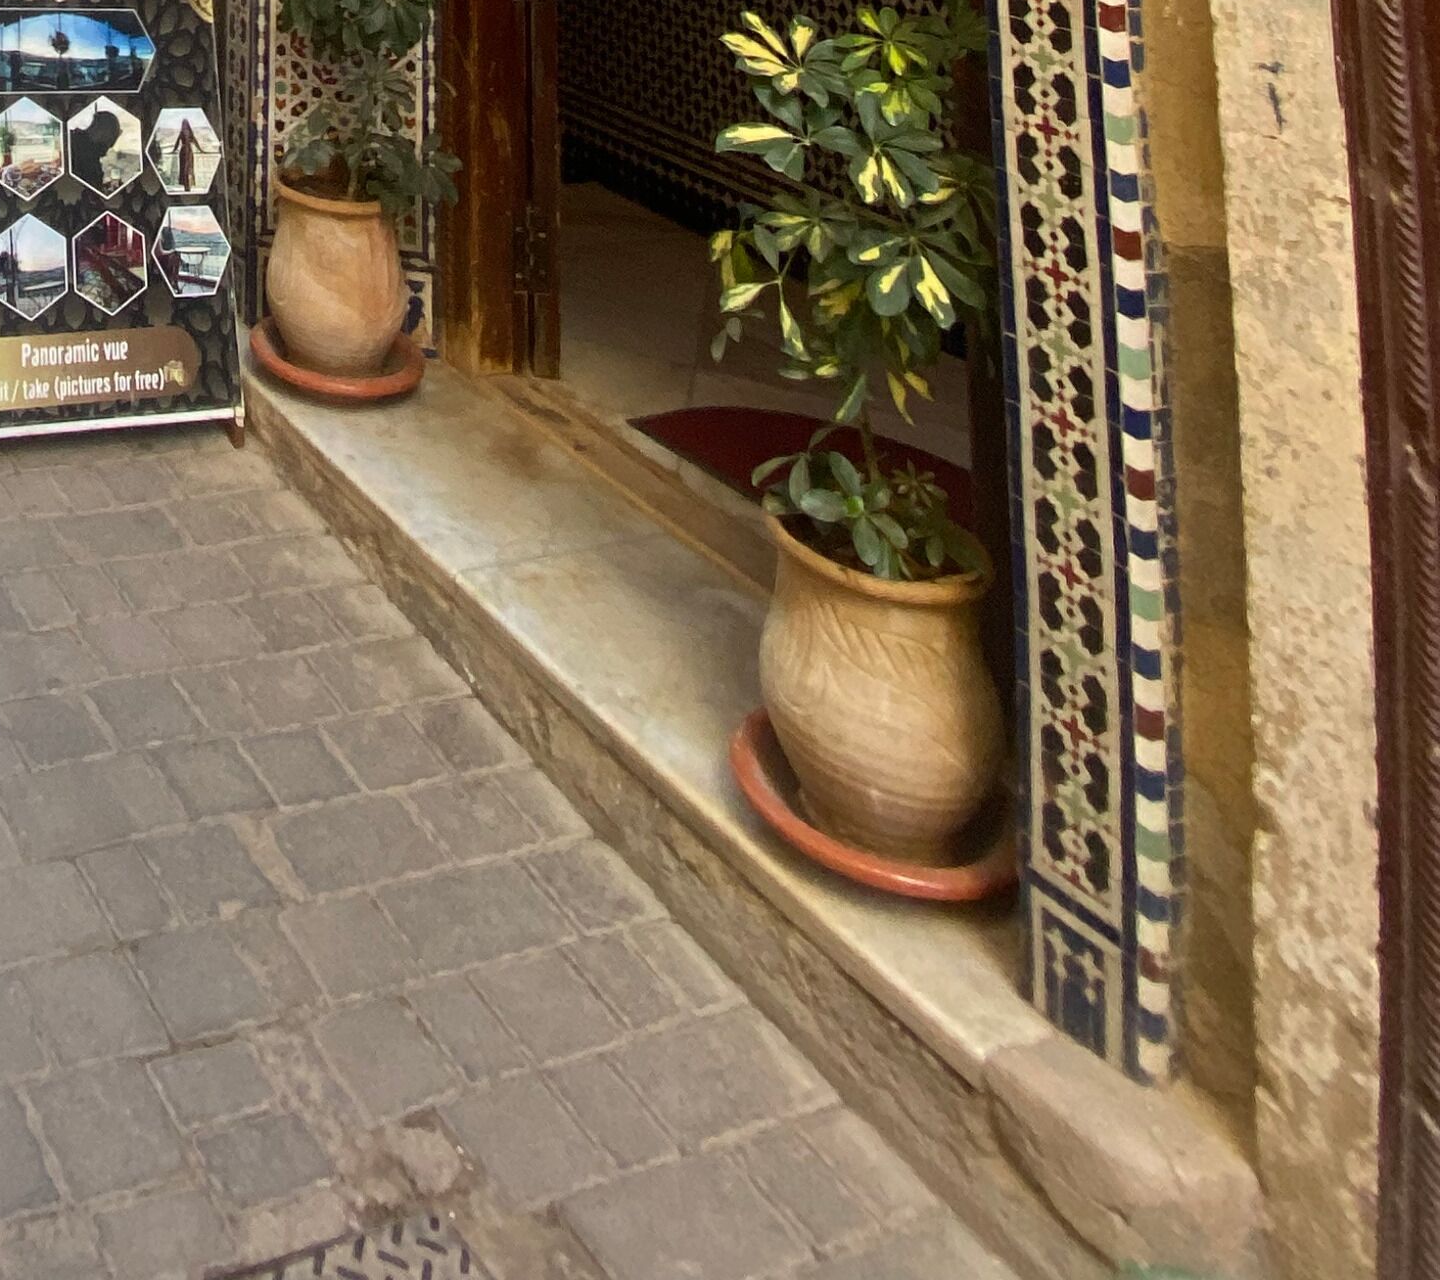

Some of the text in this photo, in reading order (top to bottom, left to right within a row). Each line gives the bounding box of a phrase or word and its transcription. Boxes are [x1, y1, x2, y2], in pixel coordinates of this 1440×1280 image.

[21, 339, 128, 368] Panoramic vue
[22, 378, 50, 400] take
[54, 374, 111, 401] (pictures
[113, 372, 131, 392] for
[134, 368, 164, 391] free)
